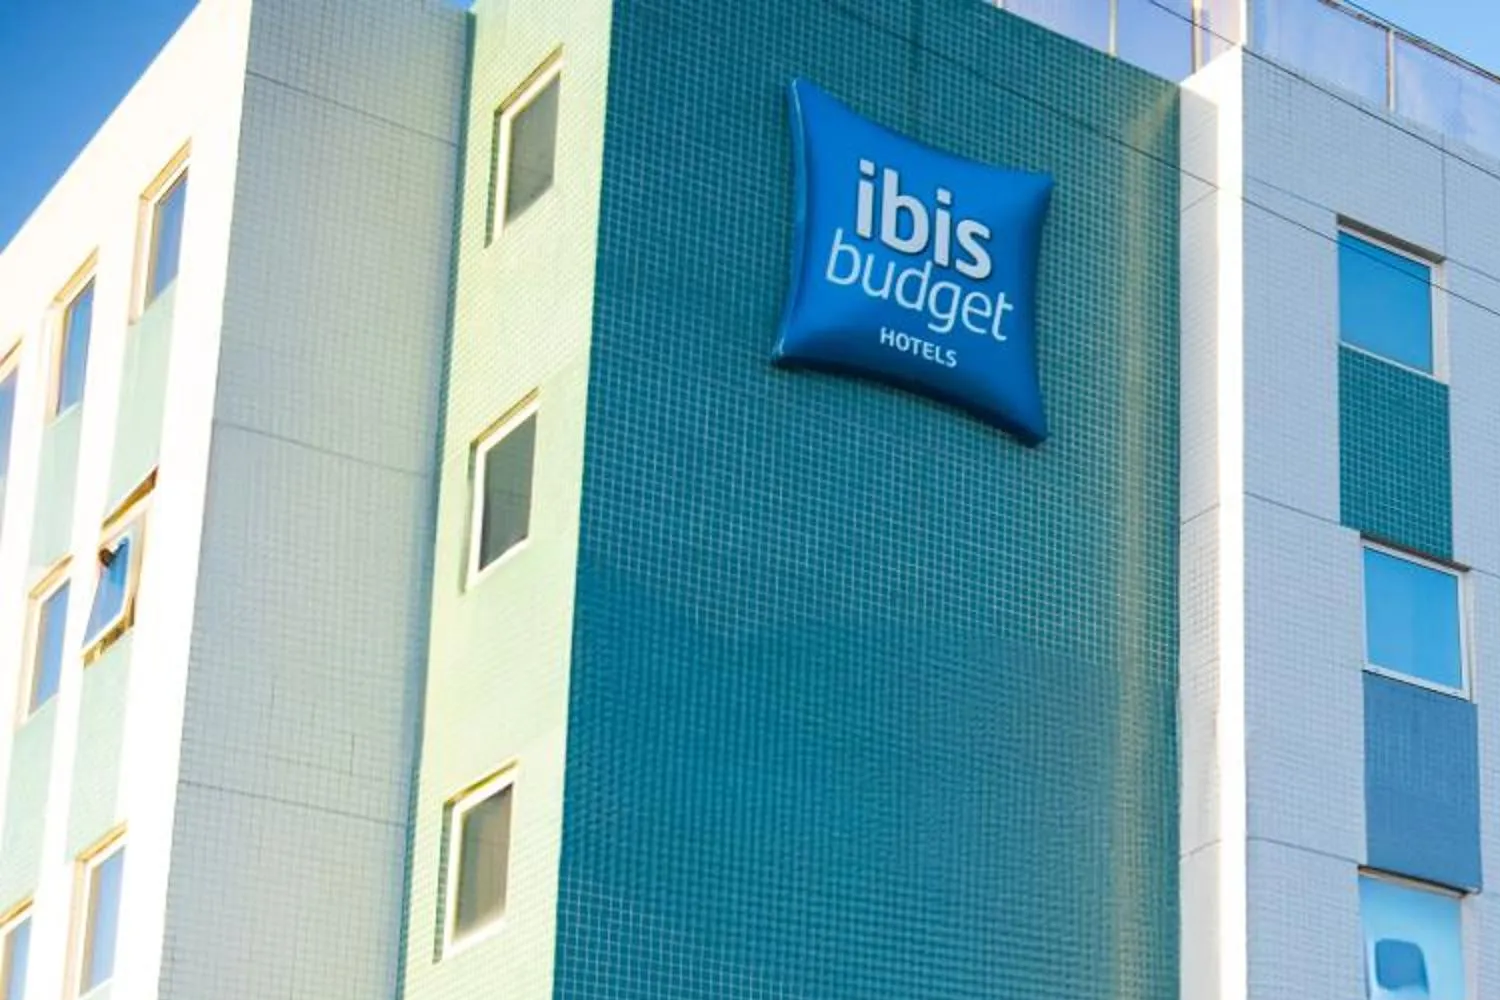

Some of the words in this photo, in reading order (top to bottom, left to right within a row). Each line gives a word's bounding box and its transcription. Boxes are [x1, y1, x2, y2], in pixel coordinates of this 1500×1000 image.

[856, 159, 992, 280] ibis
[825, 227, 1013, 341] budget
[880, 327, 957, 368] HOTELS
